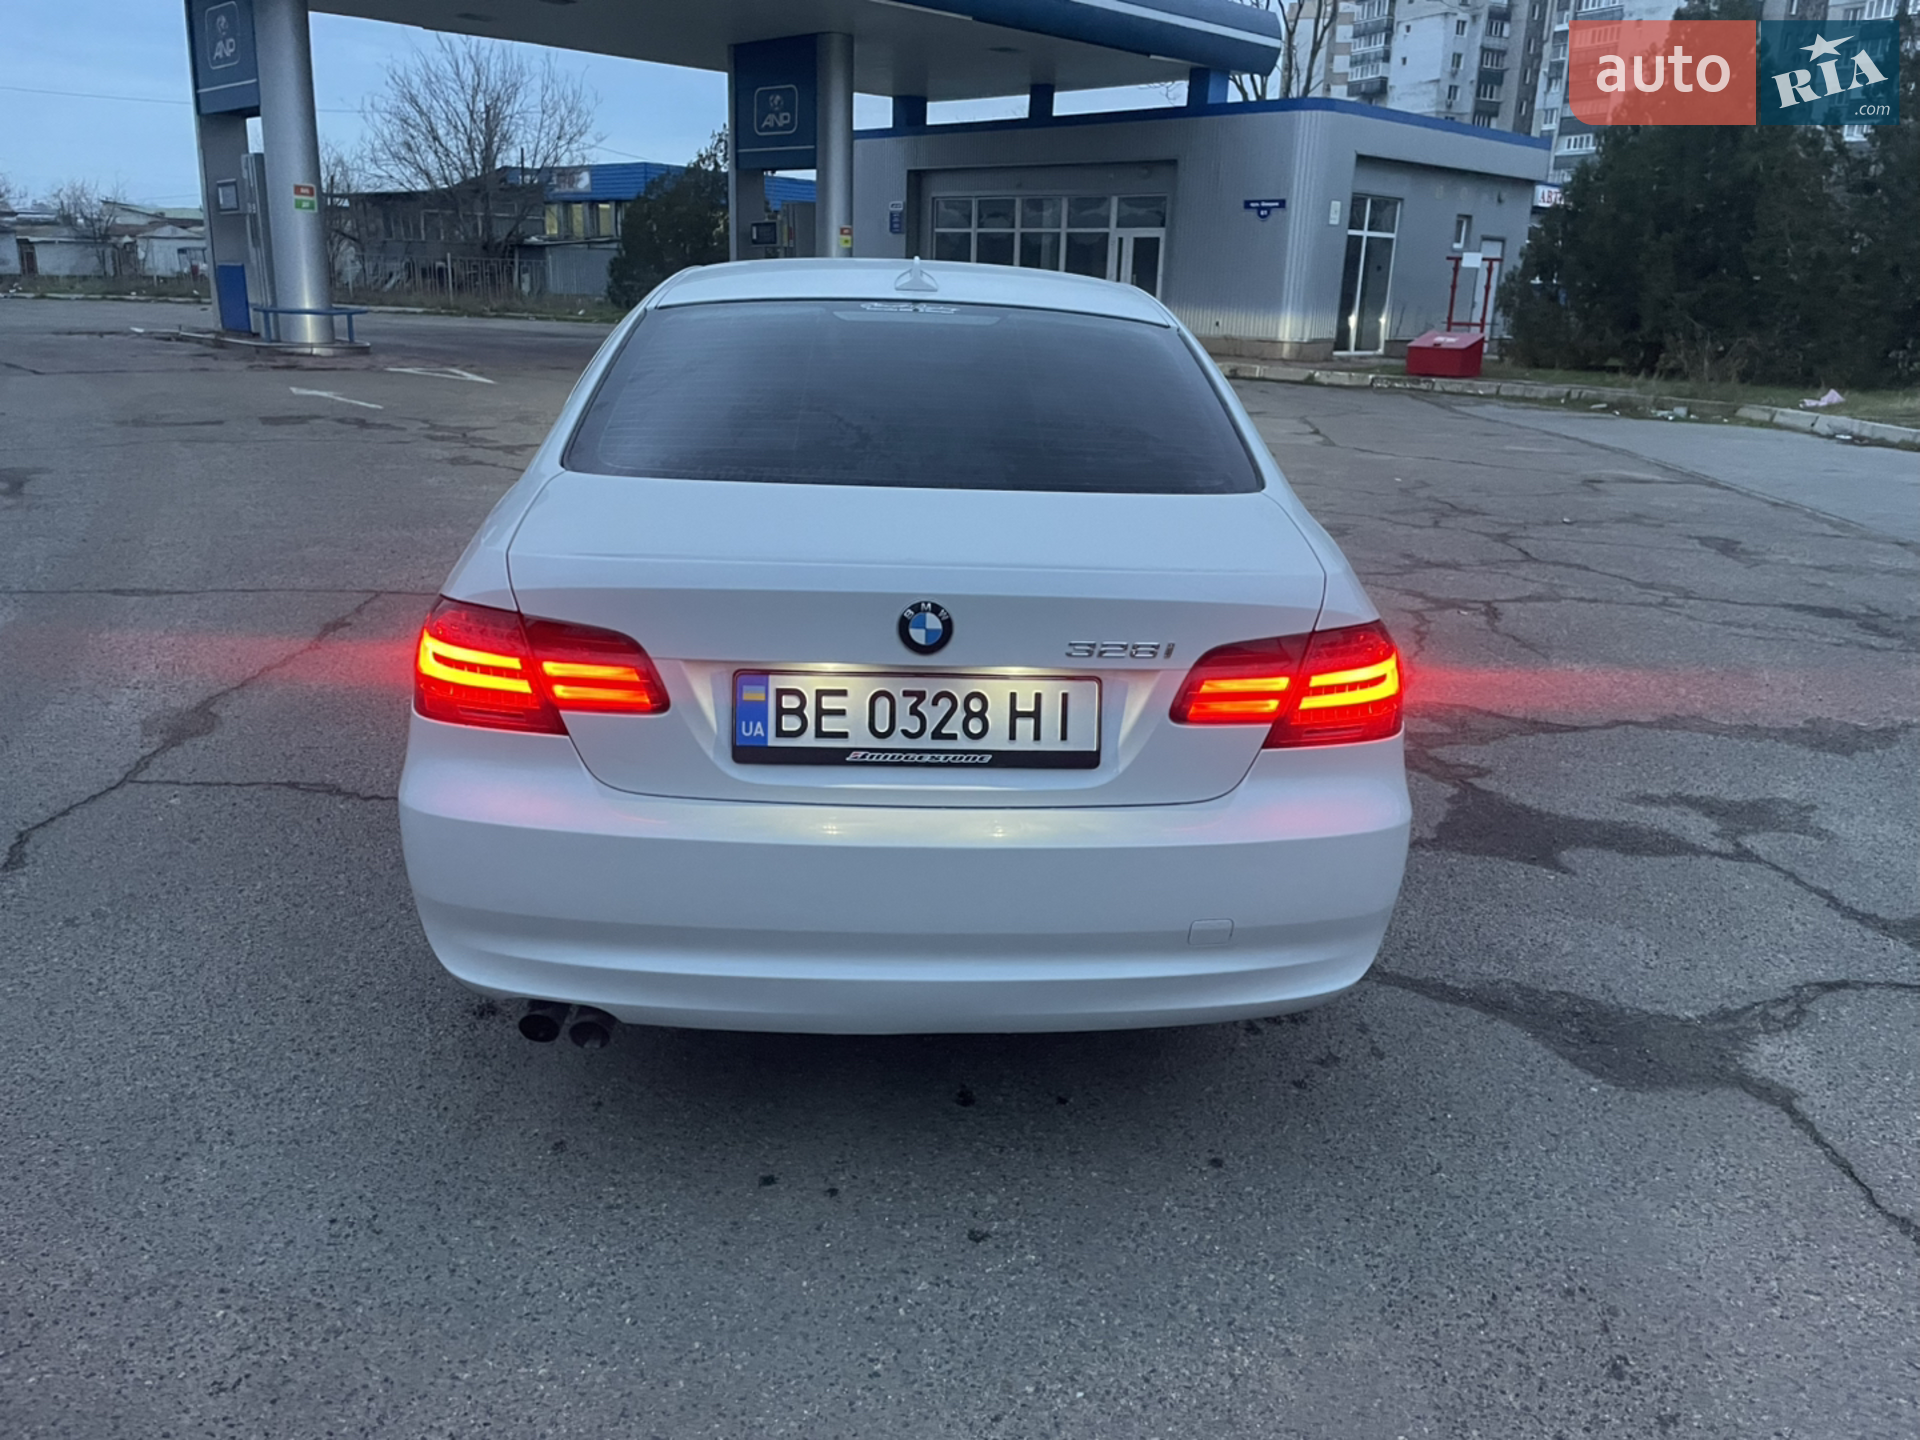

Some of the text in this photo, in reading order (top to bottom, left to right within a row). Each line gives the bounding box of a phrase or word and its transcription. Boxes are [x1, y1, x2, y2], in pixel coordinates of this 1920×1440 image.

[761, 112, 791, 128] ANP
[904, 602, 949, 620] BMW
[775, 688, 1068, 742] BE 0328 HI
[741, 721, 765, 737] UA
